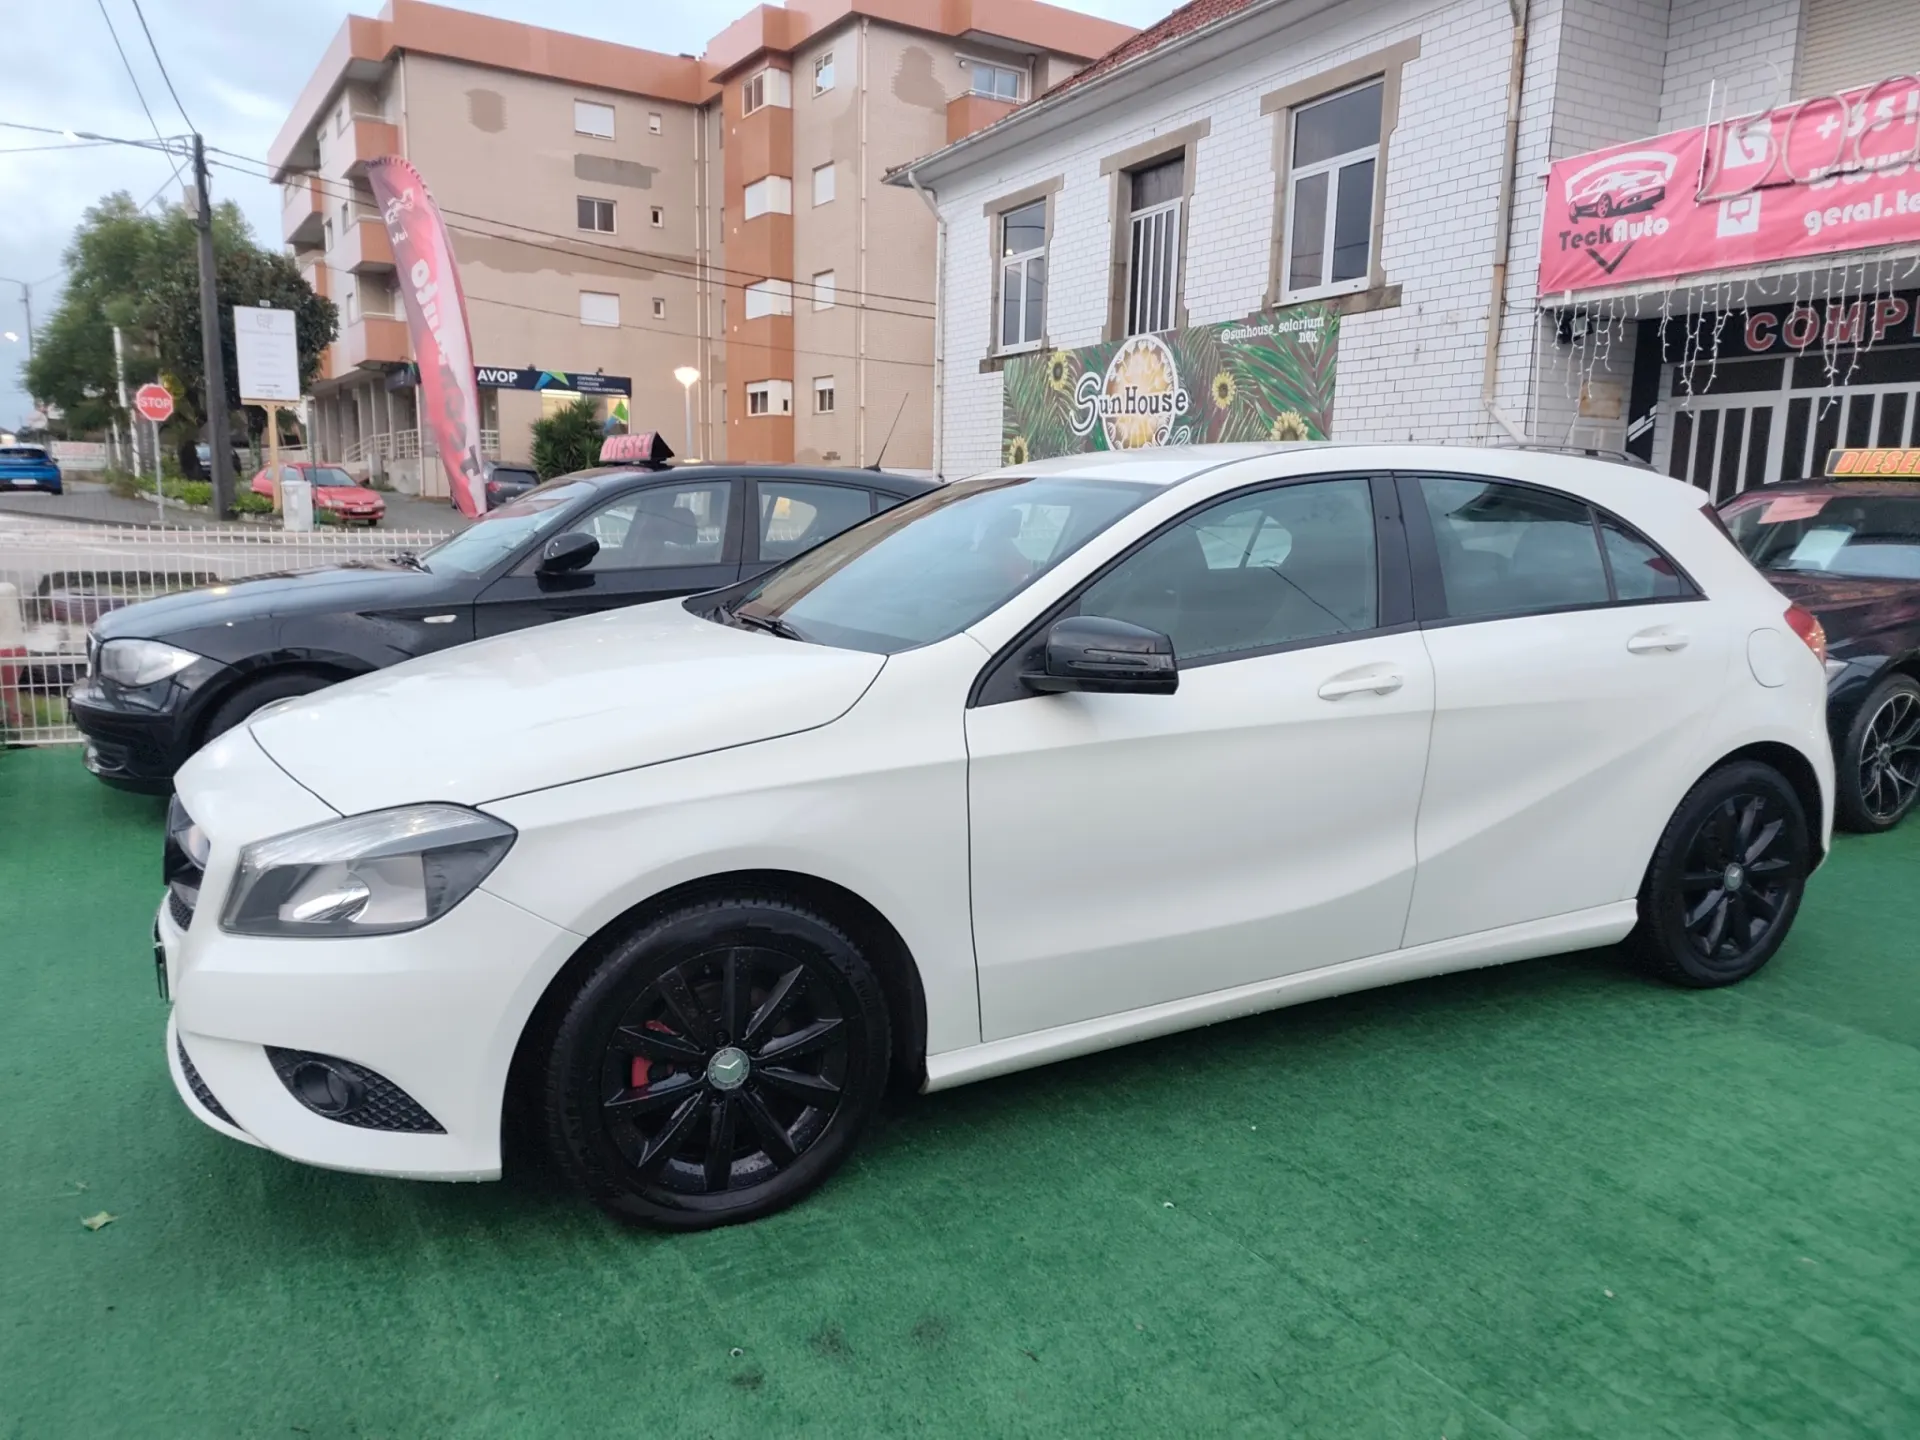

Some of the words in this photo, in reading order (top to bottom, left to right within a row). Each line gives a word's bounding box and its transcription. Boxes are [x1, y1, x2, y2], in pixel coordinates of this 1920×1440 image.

[1559, 215, 1669, 251] TeckAuto
[1744, 296, 1920, 352] COMP
[477, 369, 518, 383] AVOP
[139, 397, 171, 409] STOP
[1069, 371, 1189, 436] SunHouse
[602, 434, 652, 459] DIESEL
